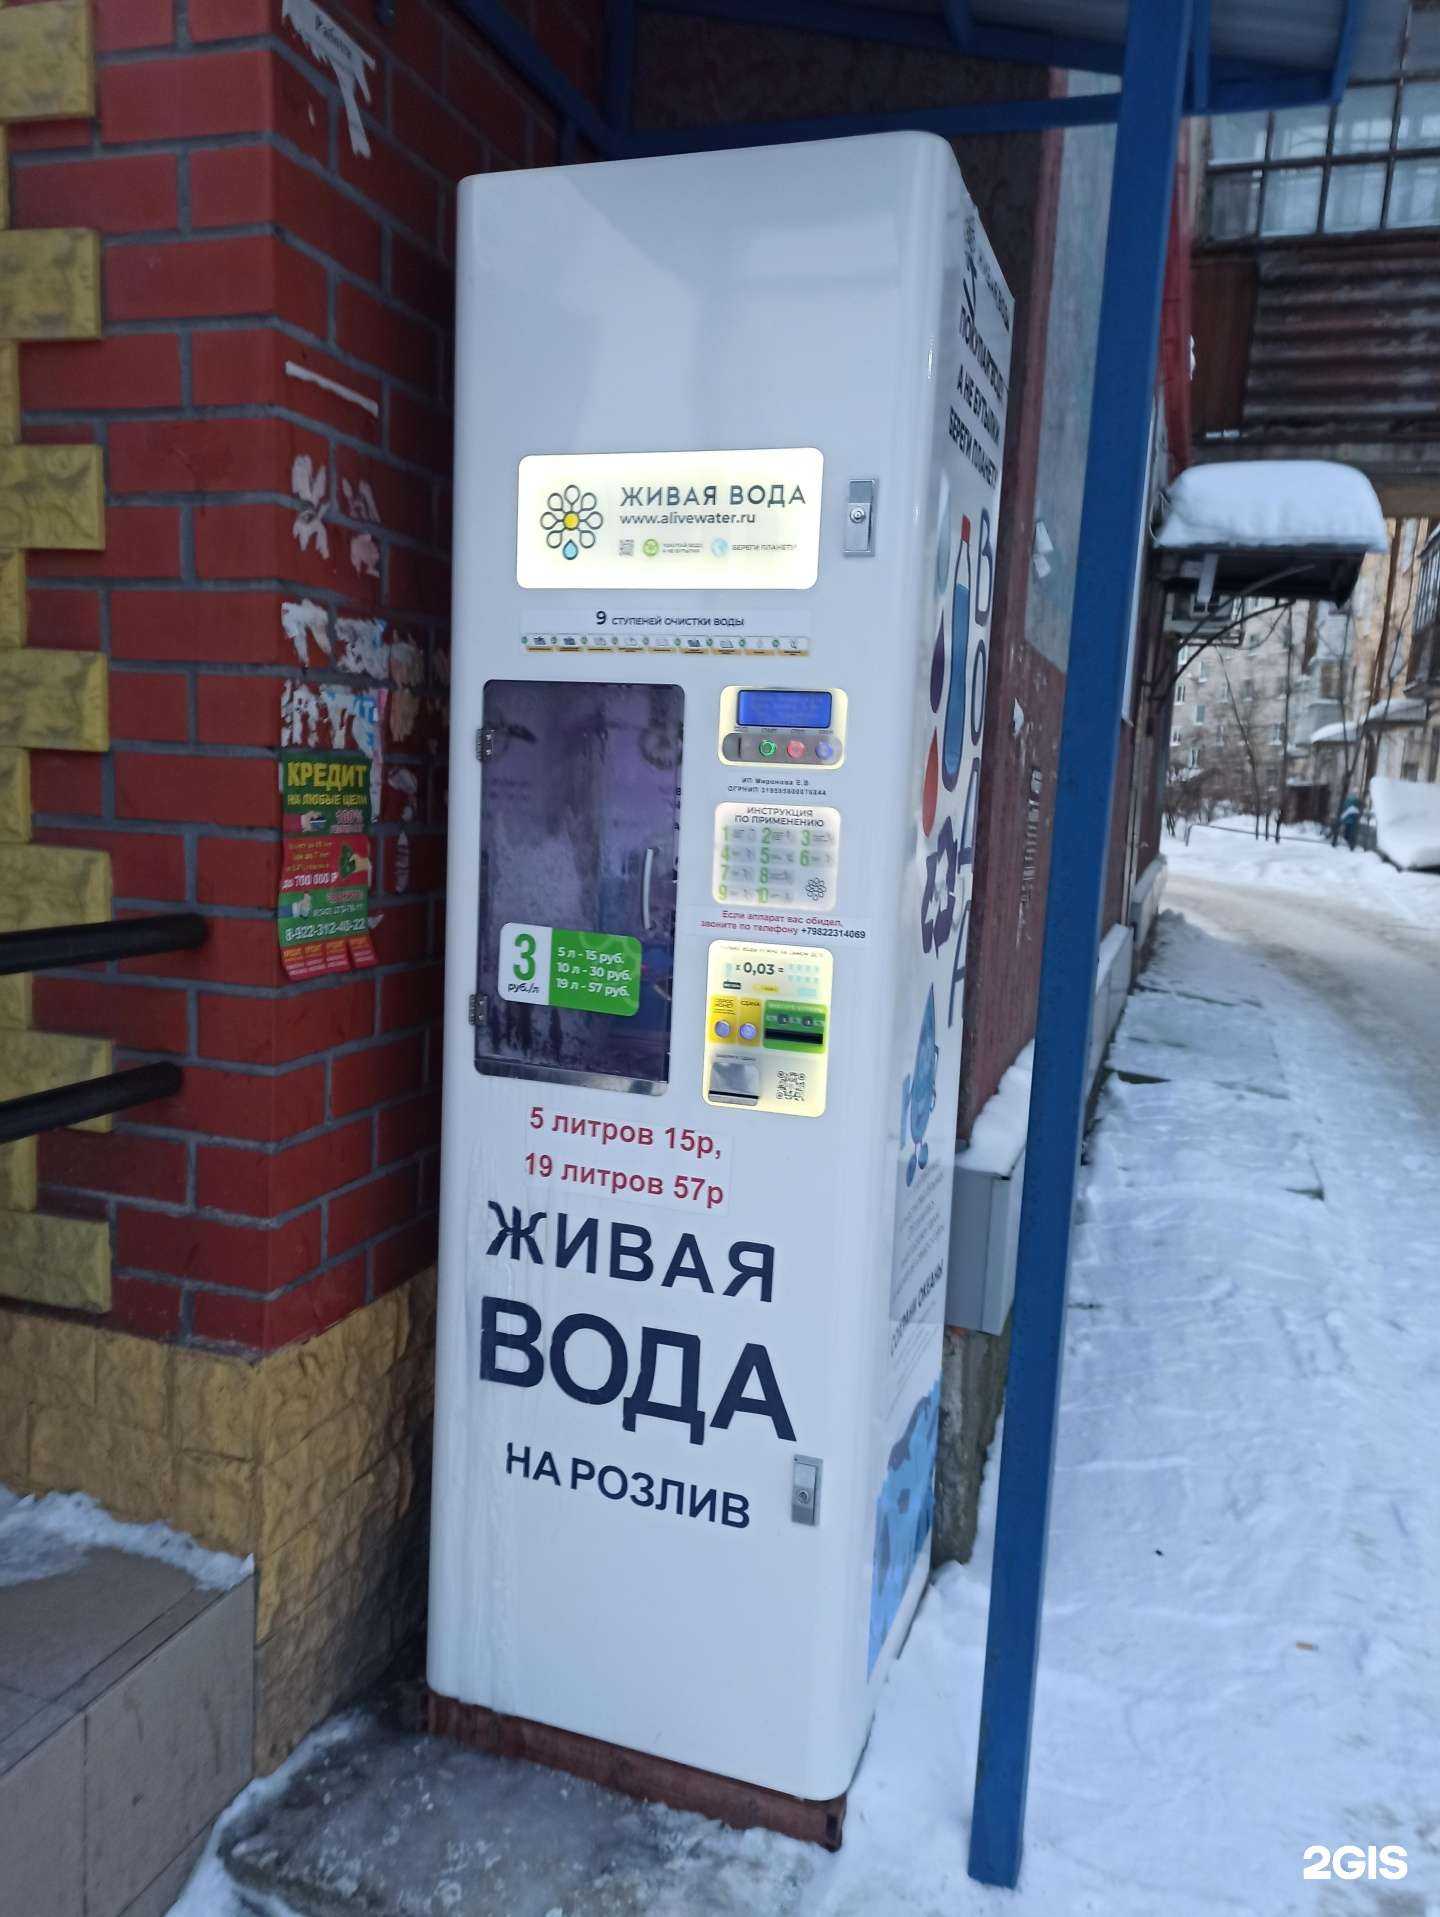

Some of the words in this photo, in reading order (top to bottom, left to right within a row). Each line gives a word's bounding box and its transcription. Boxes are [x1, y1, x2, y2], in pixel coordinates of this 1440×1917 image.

[620, 485, 718, 507] ЖИВАЯ
[729, 484, 806, 508] ВОДА
[620, 511, 755, 525] www.alivewater.ru
[596, 610, 607, 625] 9
[664, 616, 711, 627] ОЧИСТКИ
[714, 617, 745, 628] ВОДЫ
[287, 761, 367, 791] КРЕДИТ
[747, 806, 813, 817] ИНСТРУКЦИЯ
[735, 815, 749, 823] ПО
[752, 815, 824, 827] ПРИМЕНЕНИЮ
[762, 827, 771, 844] 2
[801, 829, 810, 847] 3
[760, 847, 769, 864] 5
[800, 849, 809, 867] 6
[760, 867, 769, 884] 8
[722, 910, 745, 920] Если
[748, 913, 784, 924] аппарат
[787, 916, 803, 924] вас
[753, 924, 798, 936] телефону
[513, 933, 536, 981] 3
[557, 946, 566, 957] 5
[567, 950, 576, 958] л
[585, 949, 597, 961] 15
[557, 962, 570, 973] 10
[571, 965, 580, 974] л
[589, 966, 604, 978] 30
[743, 962, 775, 976] 0,03
[556, 978, 568, 989] 19
[570, 981, 579, 990] л
[588, 982, 603, 993] 57
[530, 1106, 544, 1129] 5
[552, 1114, 653, 1145] литров
[665, 1127, 721, 1160] 15р,
[525, 1152, 553, 1177] 19
[561, 1163, 663, 1195] литров
[674, 1175, 723, 1208] 57р
[486, 1200, 775, 1302] ЖИВАЯ
[480, 1296, 797, 1445] ВОДА
[506, 1442, 561, 1486] НА
[570, 1457, 750, 1529] РОЗЛИВ
